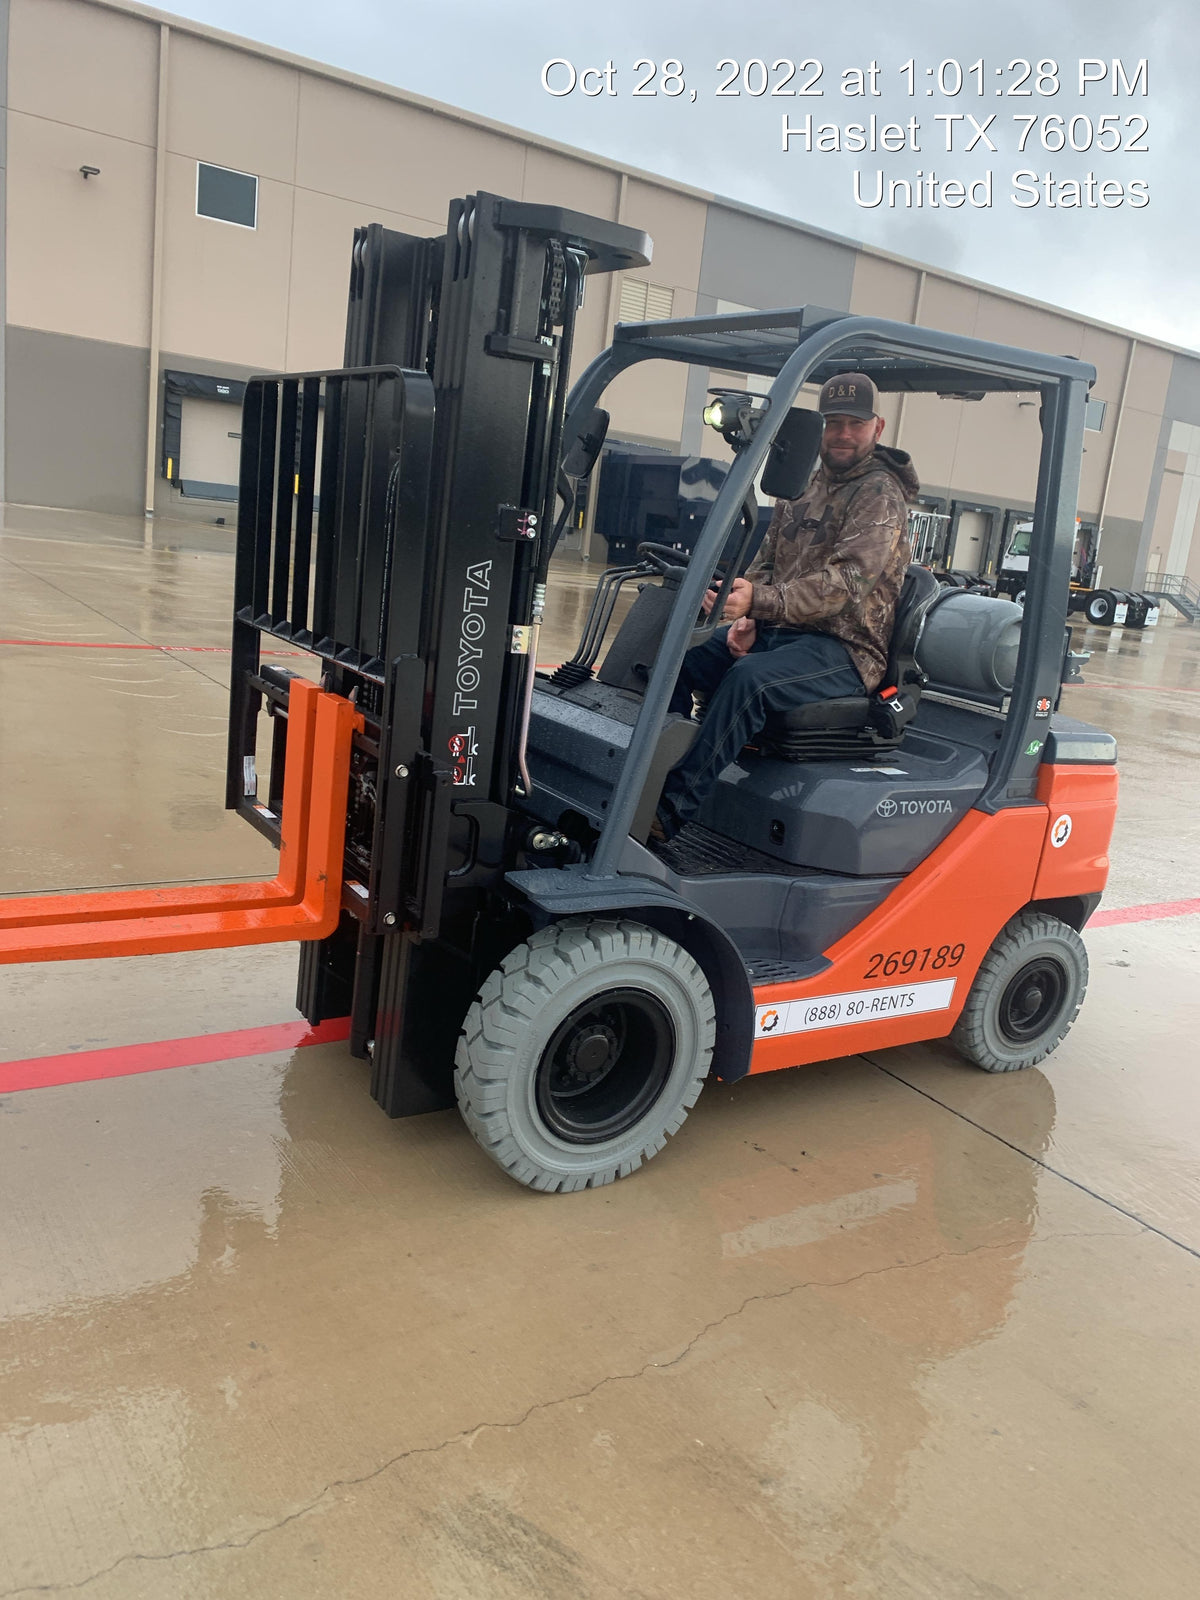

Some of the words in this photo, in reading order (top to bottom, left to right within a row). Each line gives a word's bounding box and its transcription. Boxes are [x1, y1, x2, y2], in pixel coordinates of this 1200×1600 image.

[848, 385, 856, 396] R
[452, 559, 493, 716] TOYOTA
[1036, 698, 1051, 711] SAS
[899, 799, 953, 815] TOYOTA
[863, 943, 966, 980] 269189
[804, 1002, 842, 1025] (888)
[846, 992, 915, 1017] 80-RENTS
